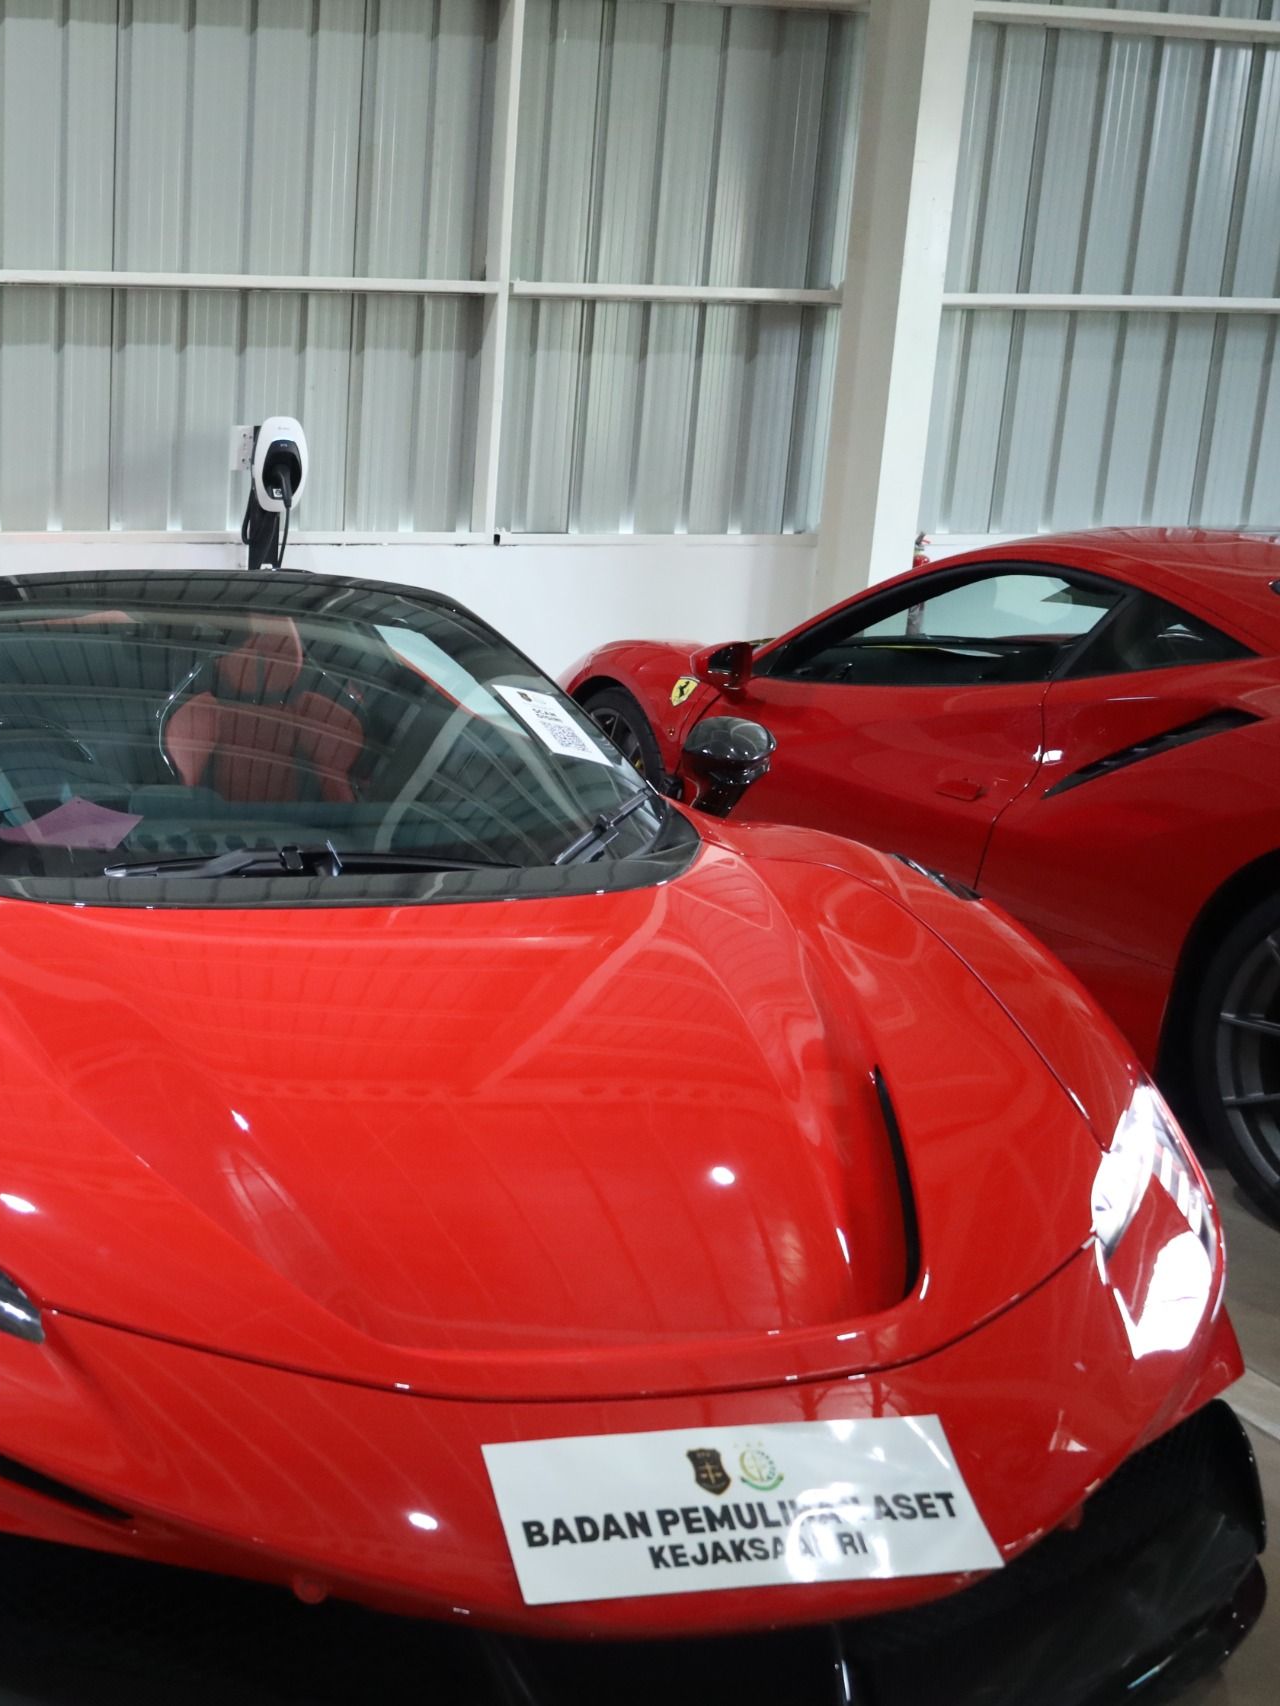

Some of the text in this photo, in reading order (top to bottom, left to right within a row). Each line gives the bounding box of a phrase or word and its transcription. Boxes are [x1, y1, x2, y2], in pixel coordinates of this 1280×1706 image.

[522, 1510, 652, 1548] BADAN
[873, 1491, 957, 1521] ASET
[836, 1530, 869, 1556] RI
